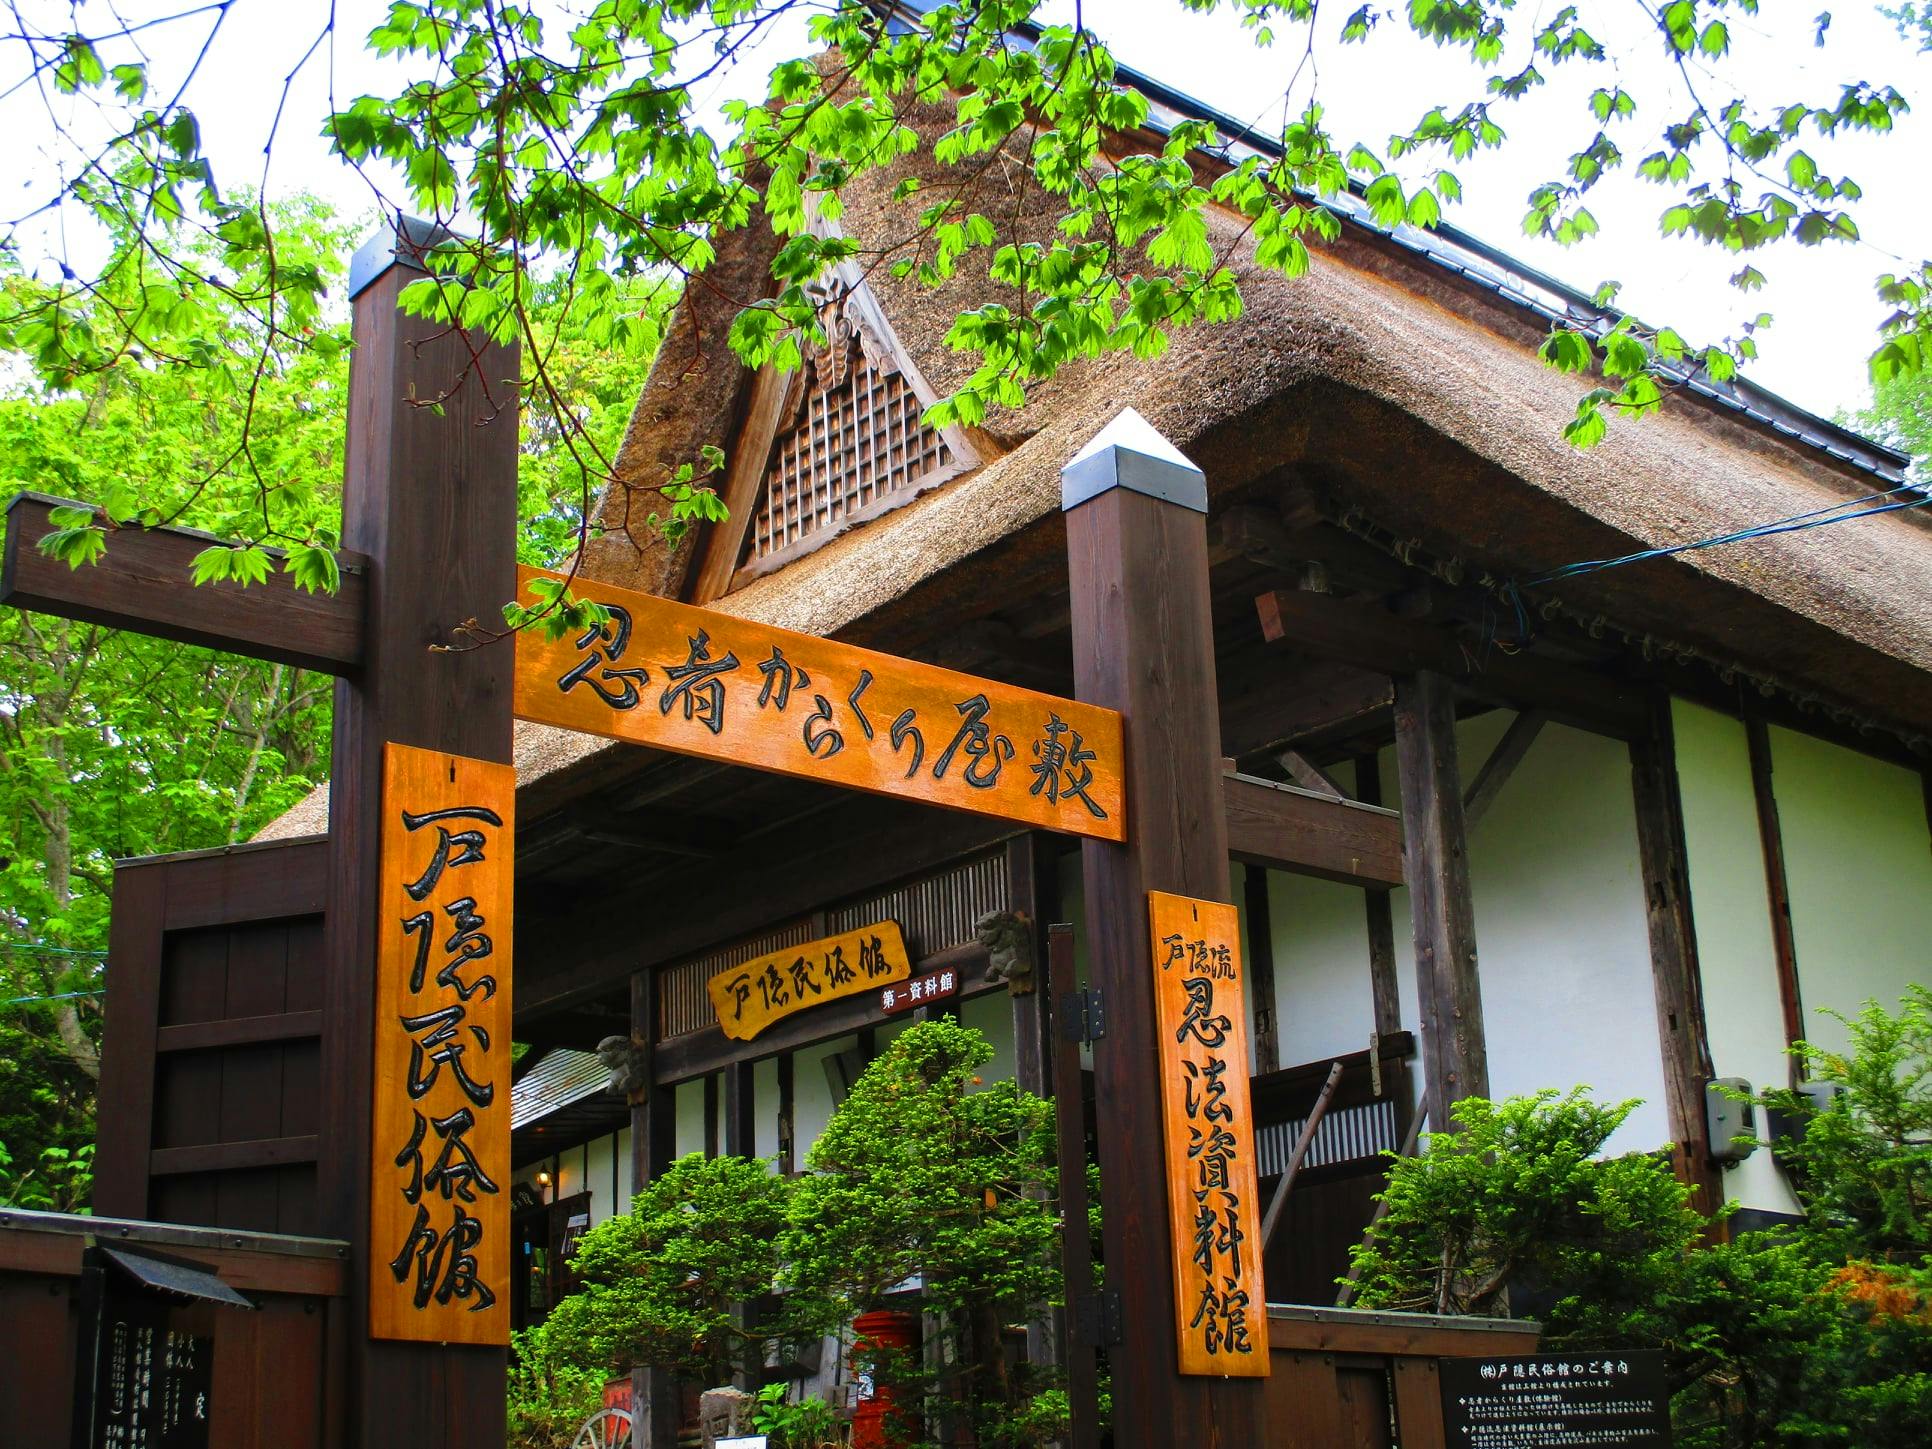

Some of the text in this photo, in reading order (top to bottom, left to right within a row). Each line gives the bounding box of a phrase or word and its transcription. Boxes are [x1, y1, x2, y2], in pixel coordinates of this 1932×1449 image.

[557, 602, 1108, 819] 忍者からくり屋敷
[724, 934, 893, 1020] 戸隠民俗館
[881, 972, 954, 1010] 第一資料館
[1161, 934, 1237, 980] 戸隠流
[388, 804, 504, 1312] 戸隠民俗館
[1175, 976, 1252, 1356] 忍法資料館
